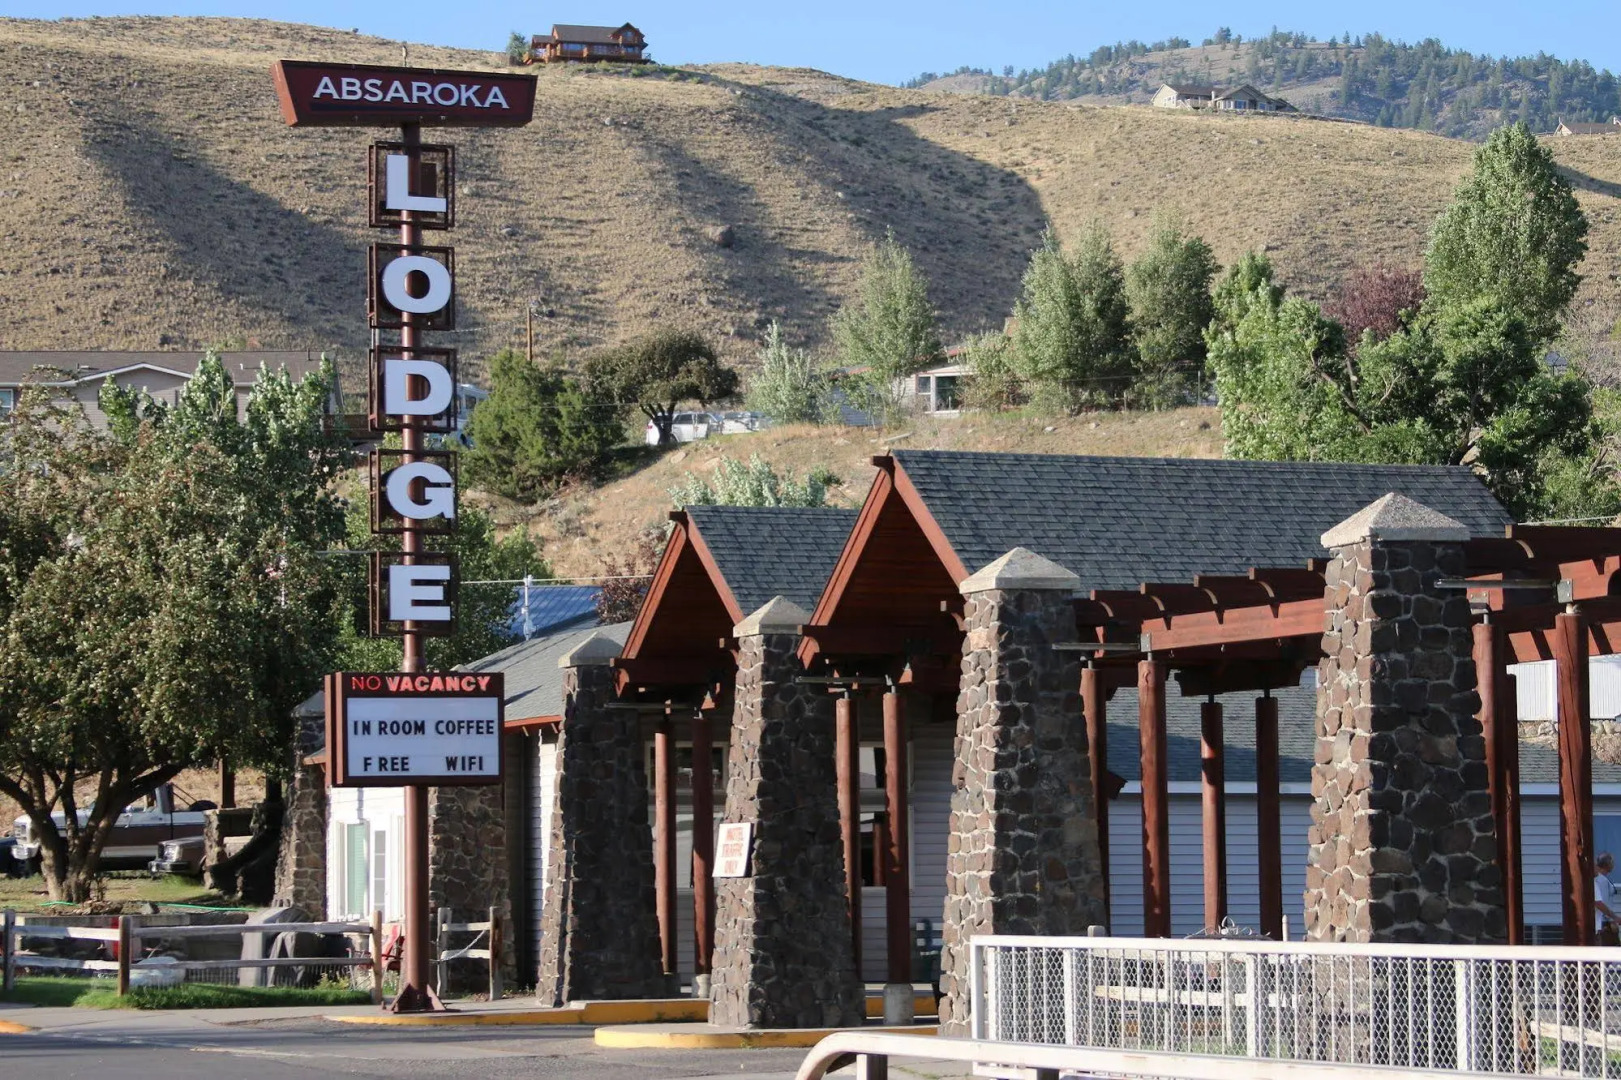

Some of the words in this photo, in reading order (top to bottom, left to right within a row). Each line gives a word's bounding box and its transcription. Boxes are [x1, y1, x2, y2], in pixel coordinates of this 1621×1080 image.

[312, 76, 510, 109] ABSAROKA
[381, 154, 456, 621] LODGE
[351, 675, 382, 691] NO
[385, 675, 491, 692] VACANCY
[353, 719, 371, 736] IN
[378, 719, 425, 736] ROOM
[434, 719, 495, 735] COFFEE
[363, 756, 410, 772] FREE
[445, 755, 484, 771] WIFI
[721, 843, 744, 857] TRAFFIC
[724, 860, 738, 874] ONLY
